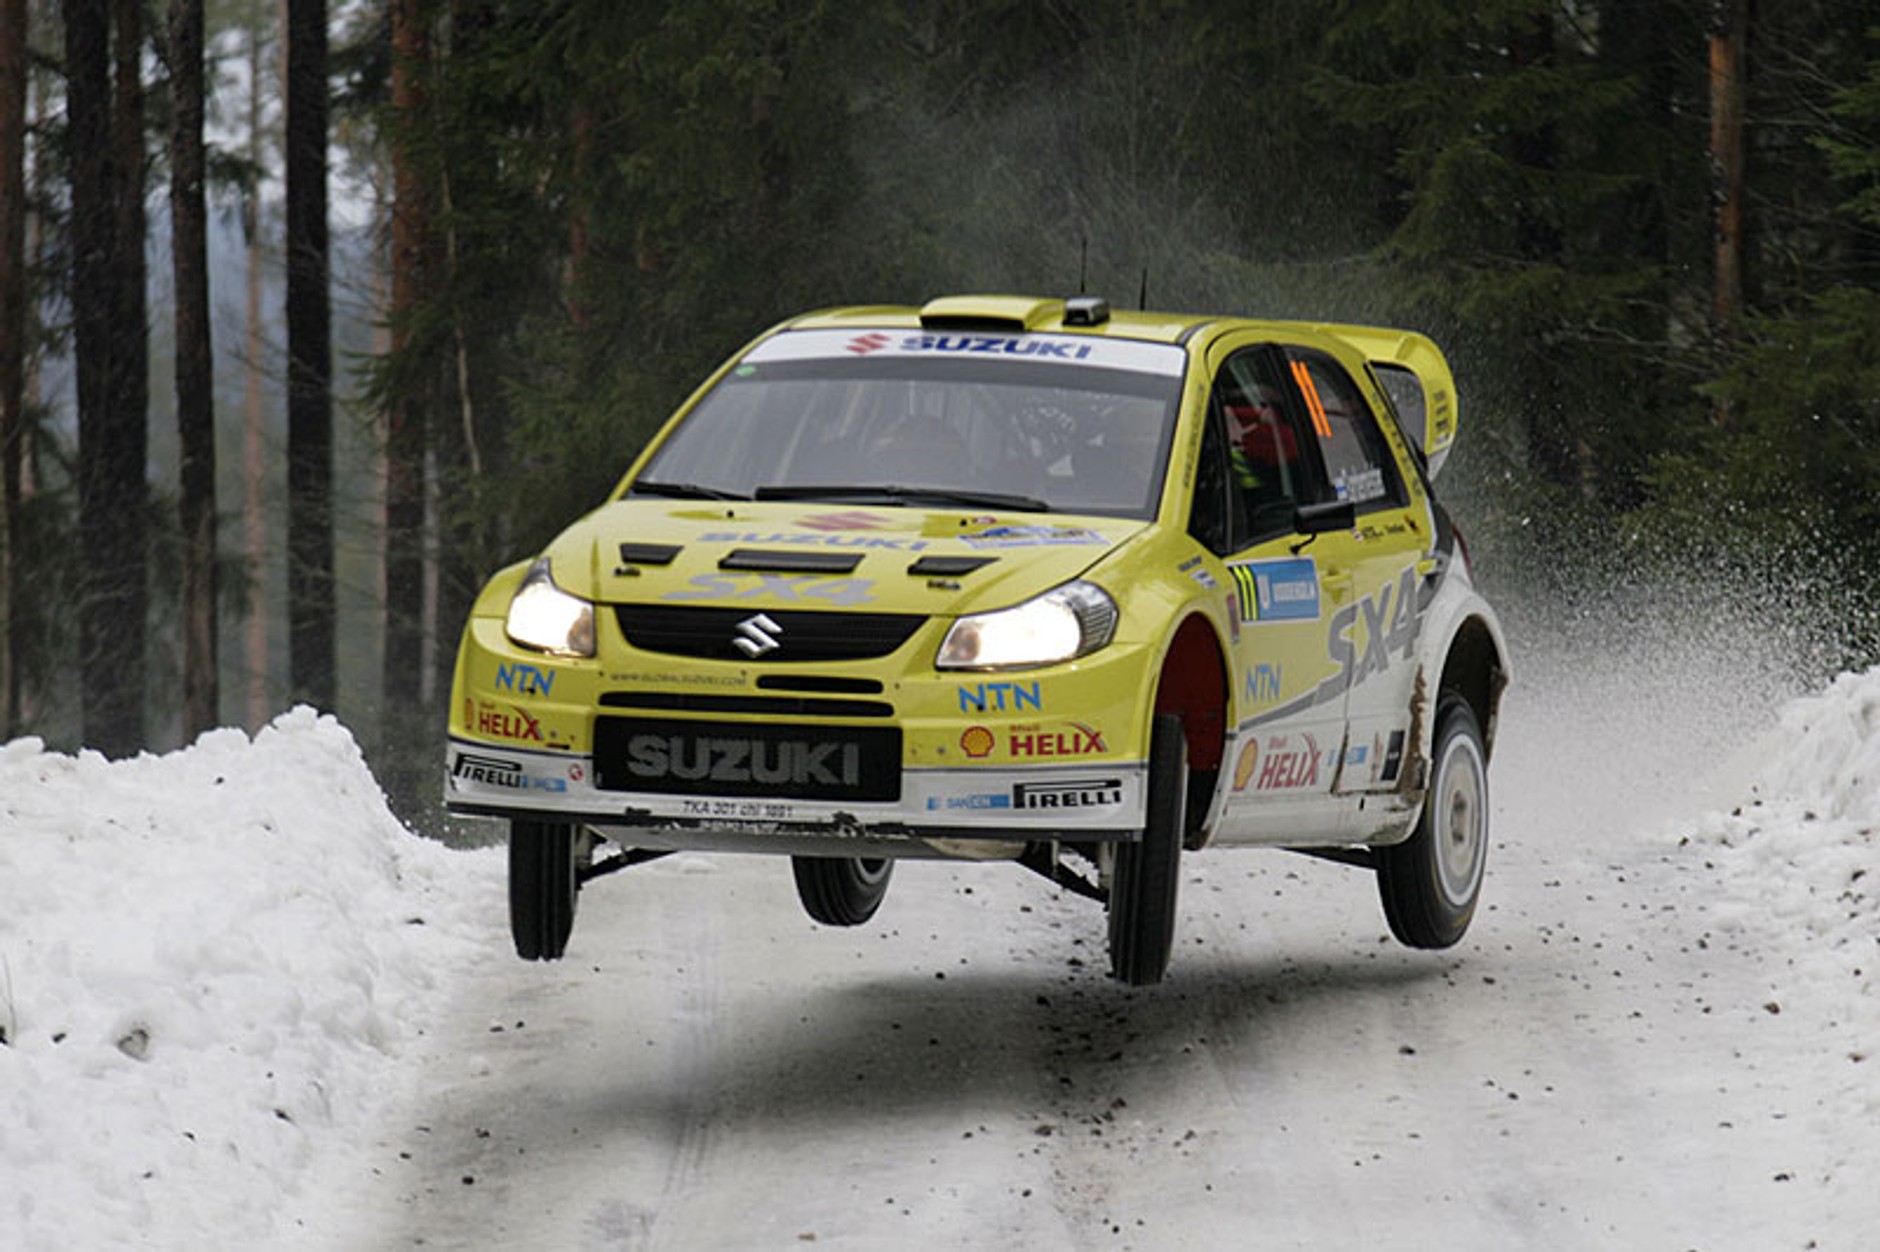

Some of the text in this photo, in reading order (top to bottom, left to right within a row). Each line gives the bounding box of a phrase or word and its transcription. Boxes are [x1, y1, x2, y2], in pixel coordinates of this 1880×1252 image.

[900, 335, 1092, 359] SUZUKI
[1289, 360, 1332, 438] 11
[697, 532, 930, 551] SUZUKI
[660, 572, 879, 606] SX4
[495, 663, 556, 697] NTN
[958, 681, 1042, 712] NTN
[1245, 663, 1282, 703] NTN
[478, 706, 544, 741] HELIX
[1010, 721, 1108, 757] HELIX
[453, 752, 523, 789] PIRELLI
[627, 734, 859, 786] SUZUKI
[1257, 732, 1322, 790] HELIX
[1013, 778, 1122, 809] PIRELLI
